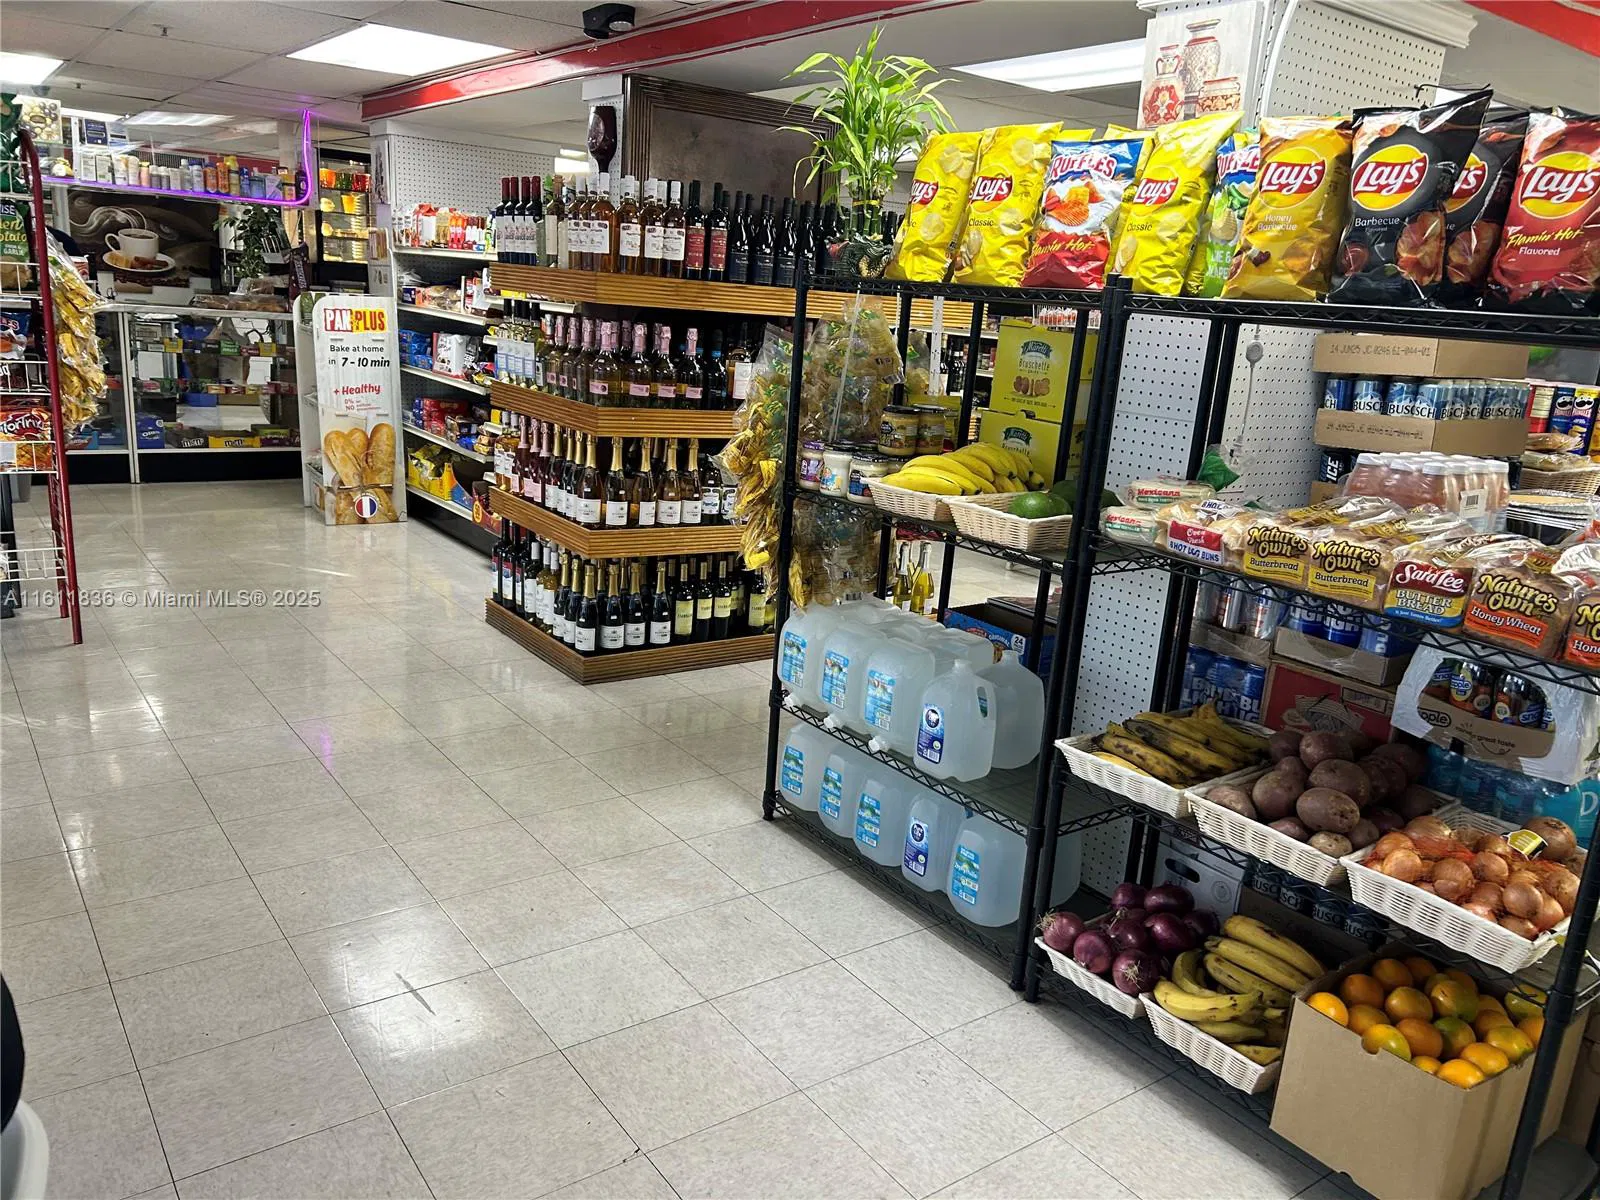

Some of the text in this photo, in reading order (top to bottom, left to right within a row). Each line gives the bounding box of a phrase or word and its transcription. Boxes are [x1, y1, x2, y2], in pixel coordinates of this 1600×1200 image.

[1051, 154, 1115, 178] RUFFLES
[1261, 162, 1324, 196] Lay's
[1354, 160, 1424, 196] Lay's
[1522, 167, 1600, 204] Lay's
[972, 177, 1011, 203] Lay's
[1134, 180, 1177, 205] Lay's
[1, 204, 15, 215] ISE
[969, 218, 994, 227] Classic
[1126, 222, 1153, 233] Classic
[1264, 214, 1292, 224] Honey
[1355, 216, 1400, 227] Barbecue
[1555, 226, 1585, 241] Hot
[1518, 246, 1560, 256] Flavored
[354, 310, 386, 332] PLUS
[341, 357, 349, 367] 7
[358, 357, 368, 367] 10
[370, 356, 390, 367] min
[341, 384, 381, 395] Healthy
[1326, 456, 1339, 482] ICE
[1137, 488, 1181, 497] Mexicana
[1247, 527, 1308, 551] Nature's
[1174, 542, 1187, 553] HOT
[1201, 551, 1219, 561] BUNS
[1258, 541, 1293, 557] Own
[1313, 541, 1381, 567] Nature's
[1250, 557, 1299, 571] Butterbread
[1324, 556, 1362, 572] Own
[1315, 572, 1369, 587] Butterbread
[1395, 564, 1465, 593] Sara Lee
[1396, 589, 1452, 607] BUTTER
[1477, 573, 1559, 614] Nature's
[1397, 599, 1446, 615] BREAD
[1488, 592, 1533, 616] Own
[1471, 605, 1542, 635] Honey Wheat
